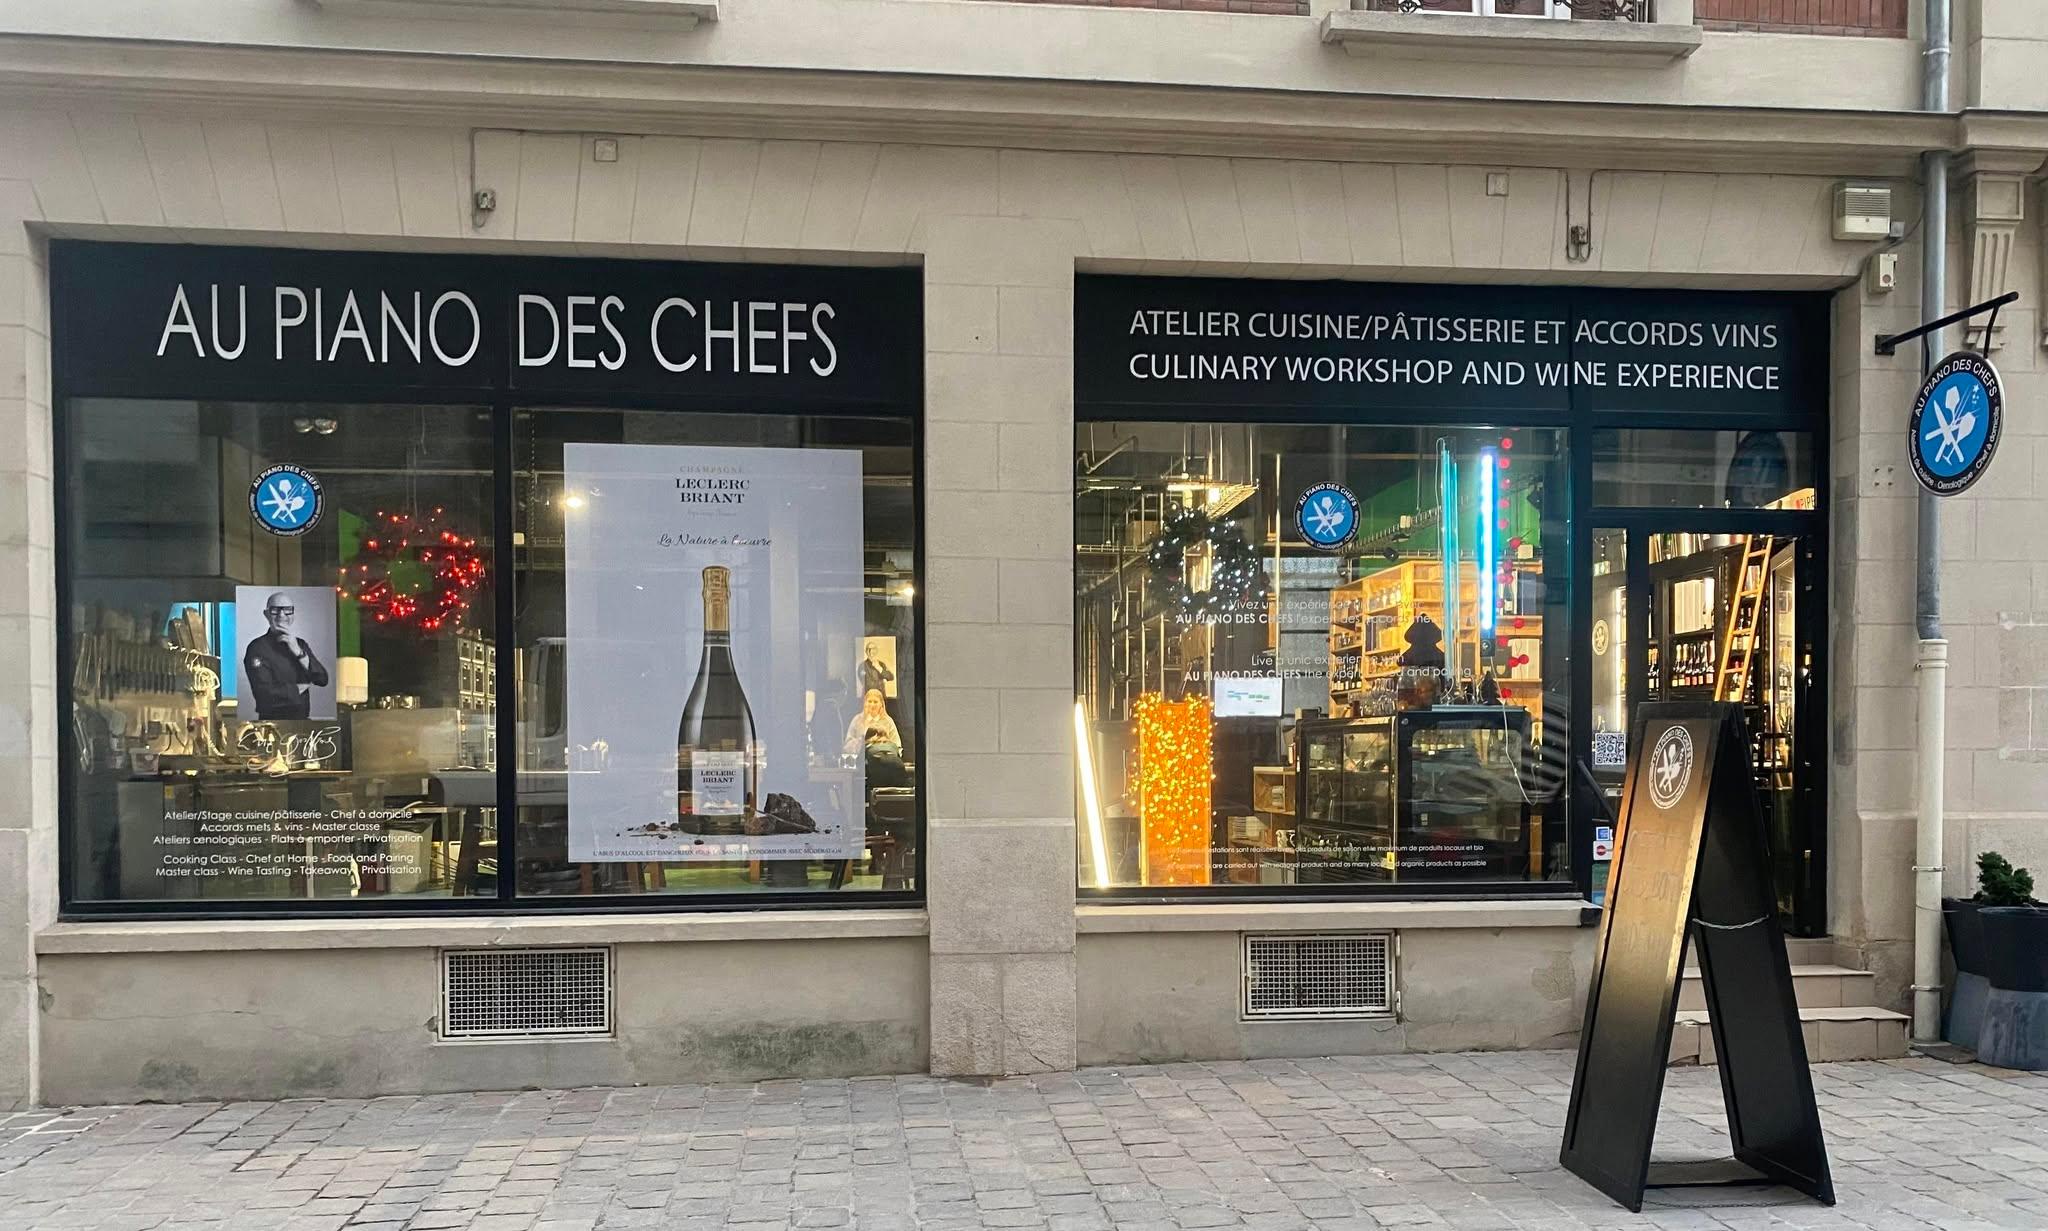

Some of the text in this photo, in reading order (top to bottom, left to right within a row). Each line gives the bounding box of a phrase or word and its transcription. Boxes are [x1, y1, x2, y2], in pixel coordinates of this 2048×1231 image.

[156, 283, 838, 377] AU PIANO DES CHEFS
[1129, 310, 1778, 349] ATELIER CUISINE/PÂTISSERIE ET ACCORDS VINS
[1129, 353, 1780, 390] CULINARY WORKSHOP AND WINE EXPERIENCE
[1915, 358, 1998, 417] AU PIANO DES CHEFS
[1975, 450, 1989, 470] Chef
[253, 465, 320, 491] AU PIANO DES CHEFS
[675, 478, 751, 491] LECLERC
[680, 492, 745, 504] BRIANT
[1299, 483, 1358, 507] AU PIANO DES CHEFS
[675, 533, 718, 546] Nature
[1228, 598, 1260, 610] Vivez
[1176, 614, 1192, 624] AU
[1195, 613, 1233, 624] PIANO
[1235, 613, 1256, 624] DES
[1251, 653, 1273, 666] Live
[1184, 671, 1200, 681] AU
[1203, 670, 1240, 680] PIANO
[1243, 669, 1264, 679] DES
[1407, 666, 1430, 677] and
[164, 810, 233, 821] Atelier/Stage
[235, 808, 322, 821] cuisine/pâtisserie
[331, 809, 357, 819] Chef
[368, 809, 413, 820] domicile
[200, 823, 244, 832] Accords
[246, 823, 271, 832] mets
[274, 823, 281, 831] &
[284, 822, 304, 832] vins
[312, 822, 347, 832] Master
[349, 821, 381, 831] classe
[153, 835, 191, 845] Ateliers
[271, 834, 294, 844] Plats
[305, 834, 355, 846] emporter
[363, 833, 424, 843] Privatisation
[1409, 844, 1418, 852] de
[1418, 845, 1443, 853] produits
[163, 855, 208, 866] Cooking
[210, 854, 237, 864] Class
[246, 854, 271, 864] Chef
[274, 854, 286, 864] at
[287, 854, 319, 863] Home
[327, 853, 354, 863] Food
[356, 853, 377, 863] and
[1301, 861, 1329, 869] products
[1352, 861, 1370, 869] many
[1426, 860, 1453, 868] products
[155, 867, 191, 877] Master
[193, 867, 219, 877] class
[228, 867, 254, 876] Wine
[255, 866, 292, 877] Tasting
[300, 865, 353, 877] Takeaway
[361, 864, 422, 875] Privatisation
